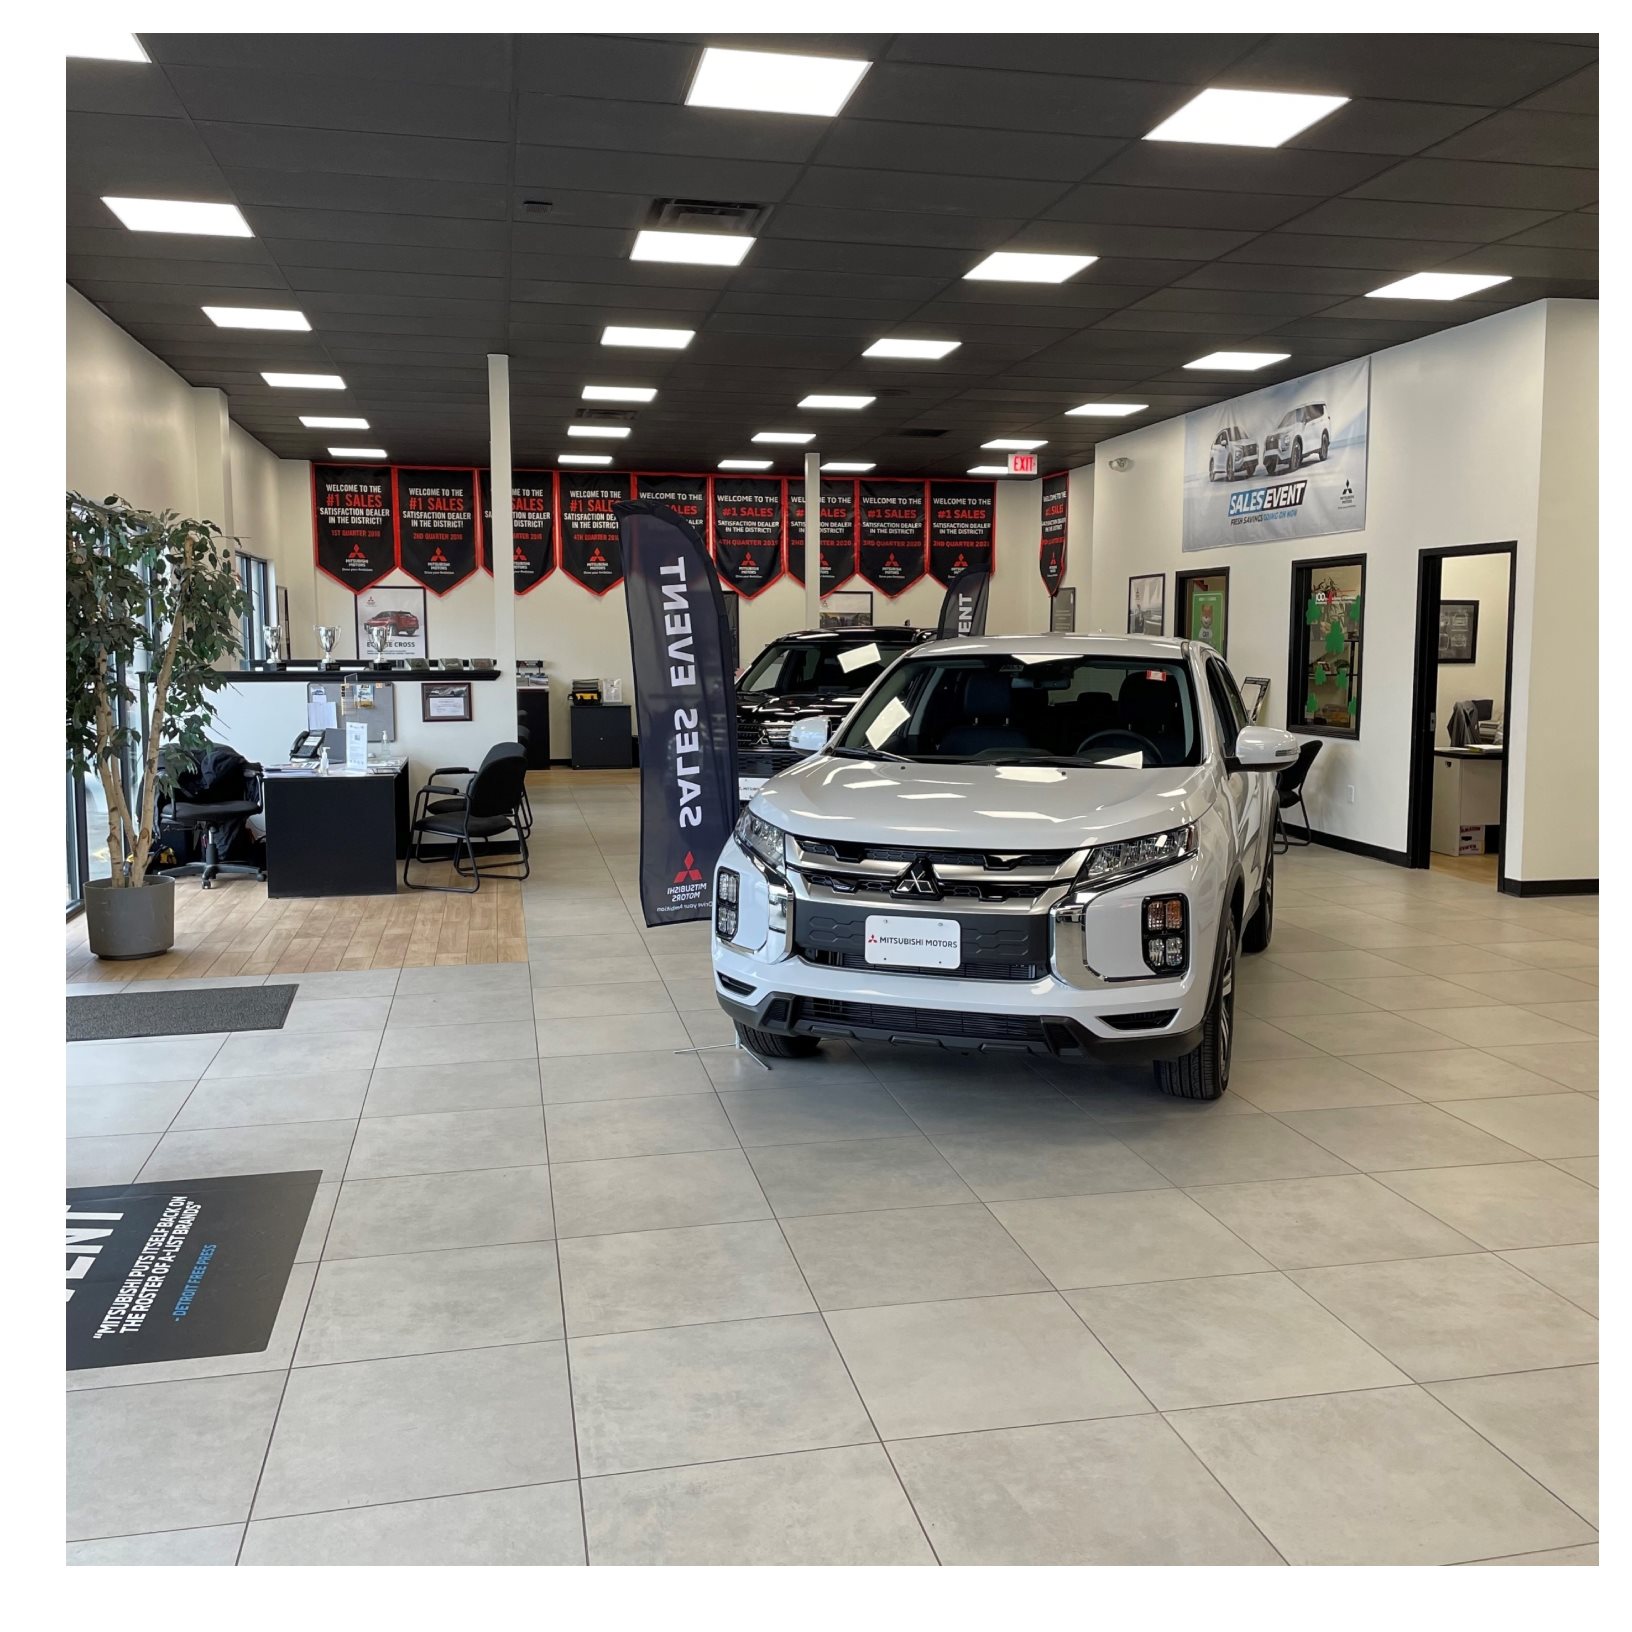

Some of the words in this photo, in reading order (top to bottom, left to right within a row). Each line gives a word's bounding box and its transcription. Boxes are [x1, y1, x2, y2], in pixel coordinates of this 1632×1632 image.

[1013, 455, 1035, 472] EXIT
[326, 484, 358, 492] WELCOME
[369, 485, 382, 493] THE
[326, 493, 340, 506] #1
[345, 494, 382, 508] SALES
[1230, 490, 1265, 515] SALES
[1263, 482, 1306, 509] EVENT
[320, 507, 364, 516] SATISFACTION
[365, 508, 390, 517] DEALER
[328, 516, 335, 524] IN
[337, 516, 349, 524] THE
[351, 517, 382, 525] DISTRICT!
[1230, 517, 1243, 525] FRESH
[1243, 514, 1263, 524] SAVINGS
[880, 936, 923, 946] MITSUBISHI
[925, 939, 958, 948] MOTORS
[168, 1196, 188, 1207] ON
[156, 1208, 182, 1228] BACK
[141, 1229, 169, 1254] ITSELF
[157, 1234, 186, 1262] A-LIST
[196, 1244, 217, 1265] PRESS
[128, 1255, 156, 1277] PUTS
[151, 1263, 171, 1275] OF
[187, 1265, 206, 1284] FREE
[131, 1275, 166, 1312] ROSTER
[172, 1285, 199, 1316] DETROIT
[119, 1313, 146, 1334] THE
